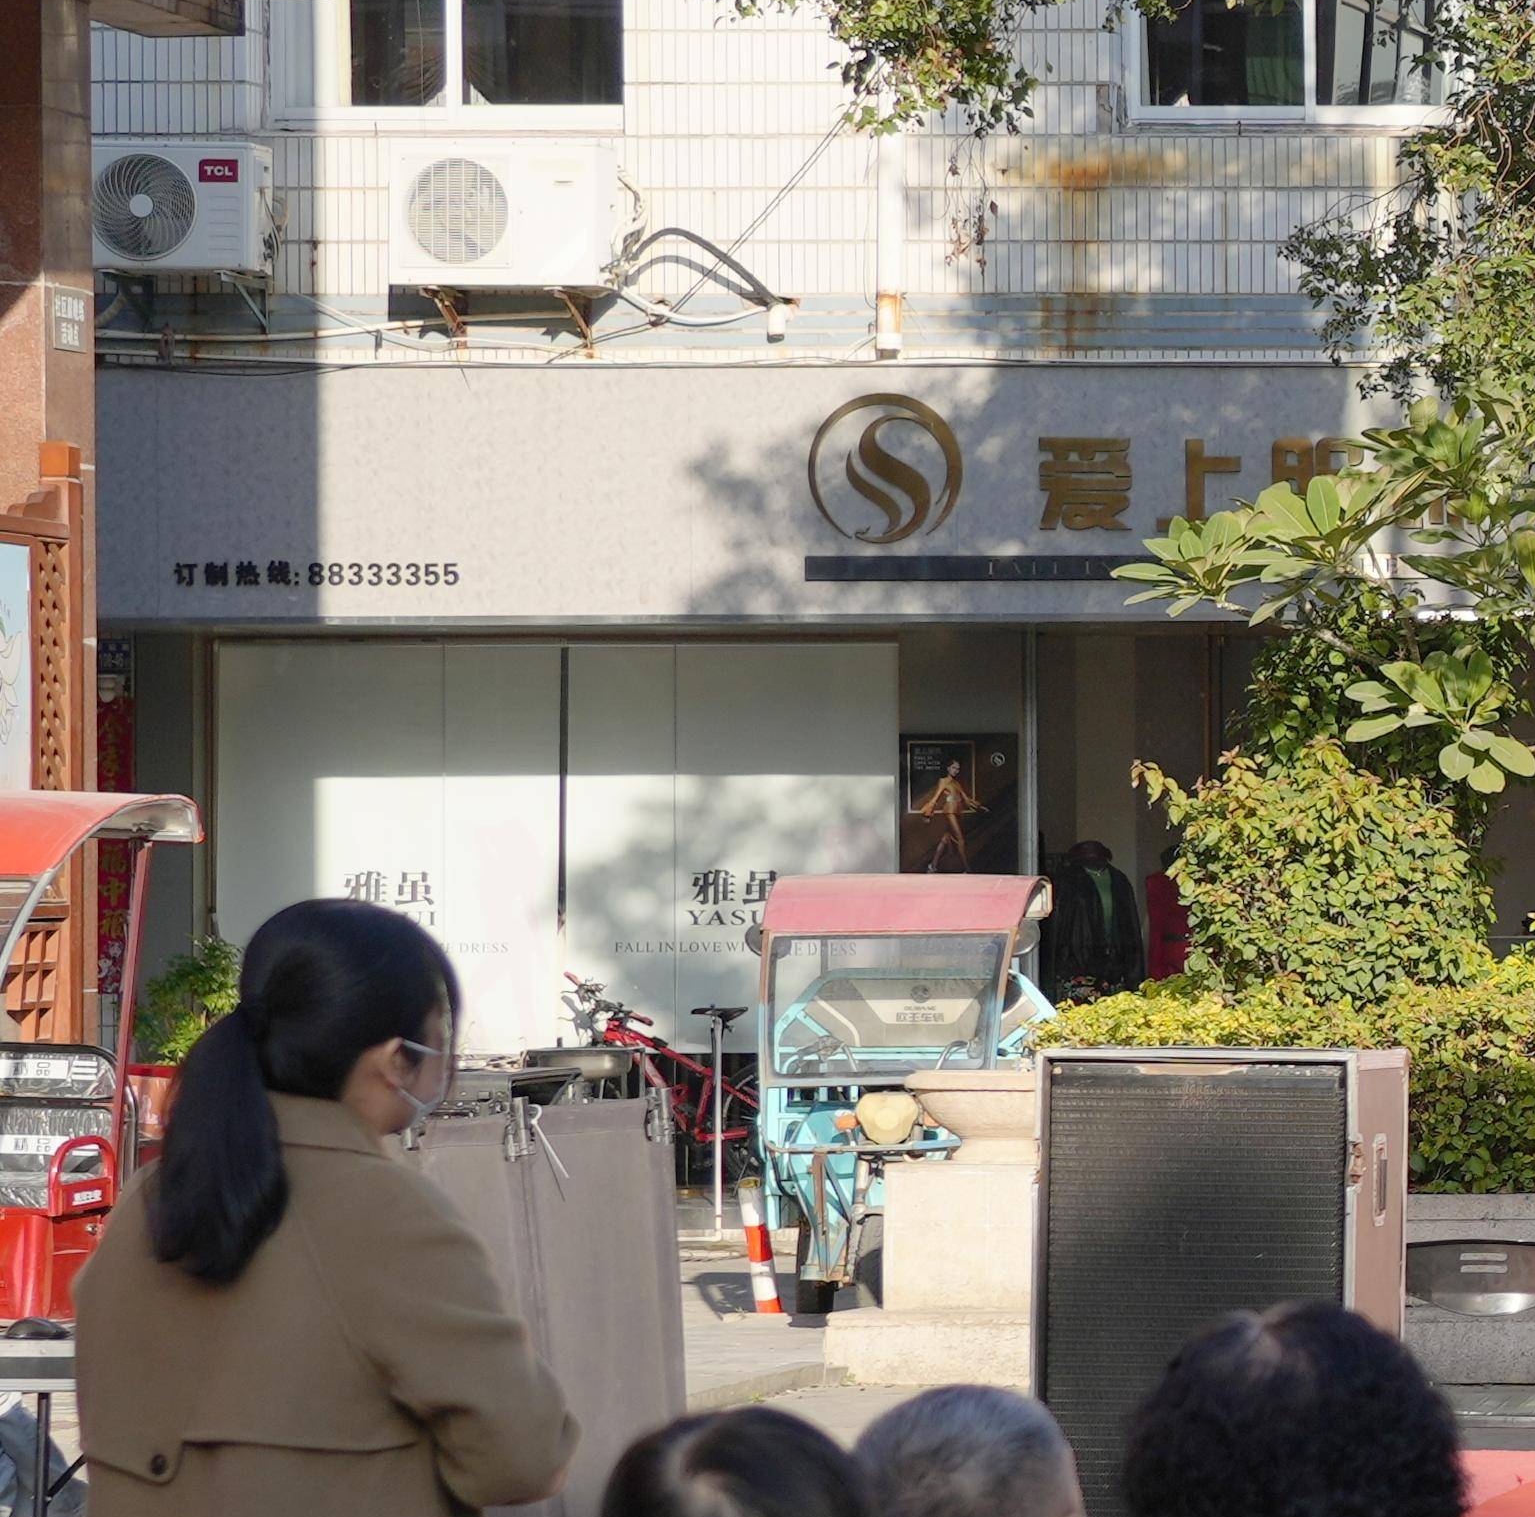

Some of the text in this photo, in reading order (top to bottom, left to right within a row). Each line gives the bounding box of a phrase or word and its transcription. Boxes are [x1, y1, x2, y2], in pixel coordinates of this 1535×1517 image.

[203, 166, 233, 177] TCL
[459, 942, 510, 954] DRESS
[614, 941, 654, 953] FALL
[658, 941, 674, 953] IN
[679, 941, 722, 953] LOVE
